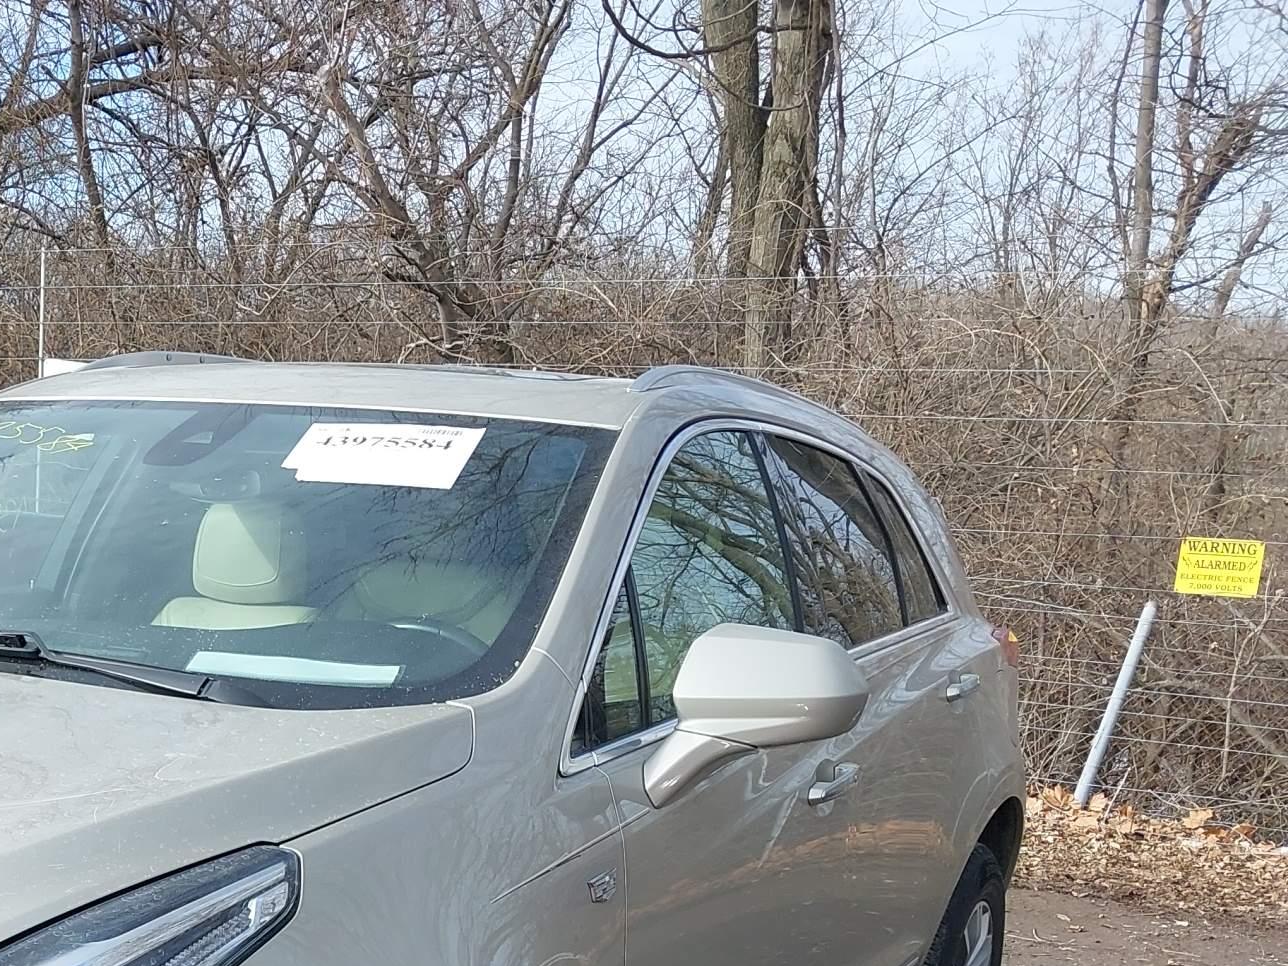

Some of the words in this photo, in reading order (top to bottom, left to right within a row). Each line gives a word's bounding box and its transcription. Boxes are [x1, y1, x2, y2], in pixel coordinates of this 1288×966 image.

[315, 434, 454, 451] 43975584
[1188, 540, 1258, 556] WARNING
[1193, 559, 1247, 572] ALARMED
[1180, 572, 1224, 583] ELECTRIC
[1225, 575, 1255, 584] FENCE
[1215, 584, 1243, 592] VOLTS
